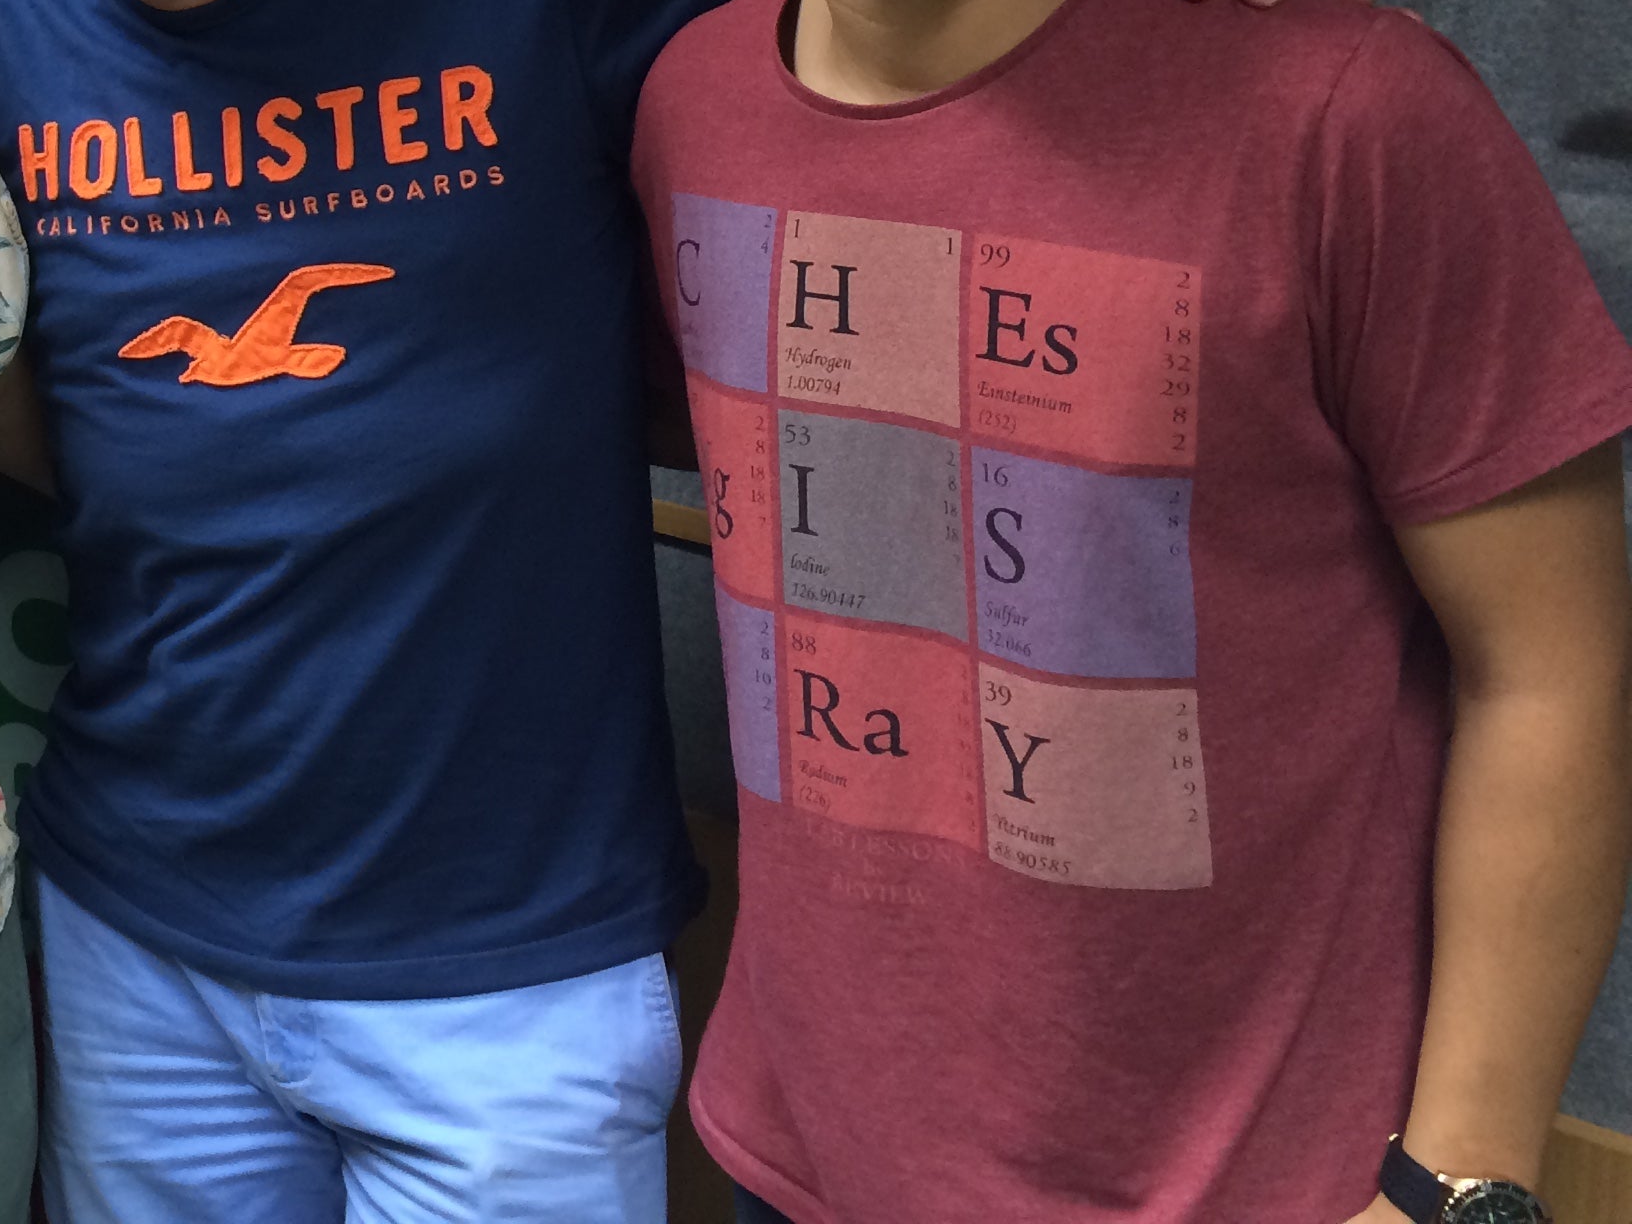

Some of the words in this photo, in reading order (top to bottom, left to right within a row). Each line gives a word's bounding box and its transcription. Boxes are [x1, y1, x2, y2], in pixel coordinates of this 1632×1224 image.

[18, 65, 499, 202] HOLLISTER
[37, 205, 232, 238] CALIFORNIA
[255, 166, 505, 223] SURFBOARDS
[794, 218, 801, 238] 1
[947, 237, 953, 255] 1
[980, 243, 1011, 269] 99
[676, 238, 701, 307] C
[1176, 271, 1191, 289] 2
[785, 259, 860, 336] H
[1174, 299, 1189, 317] 8
[975, 285, 1079, 376] Es
[1164, 326, 1192, 345] 18
[785, 347, 852, 373] Hydrogen
[1160, 353, 1191, 373] 32
[787, 376, 841, 396] 1.00794
[977, 380, 1072, 415] Einsteinium
[1160, 379, 1191, 397] 29
[978, 408, 1017, 434] (252)
[1172, 407, 1187, 424] 8
[784, 424, 811, 446] 53
[1171, 434, 1186, 452] 2
[982, 462, 1010, 488] 16
[788, 463, 819, 536] I
[983, 507, 1026, 585] S
[791, 632, 817, 656] 88
[984, 680, 1013, 706] 39
[793, 668, 910, 758] Ra
[984, 717, 1051, 804] Y
